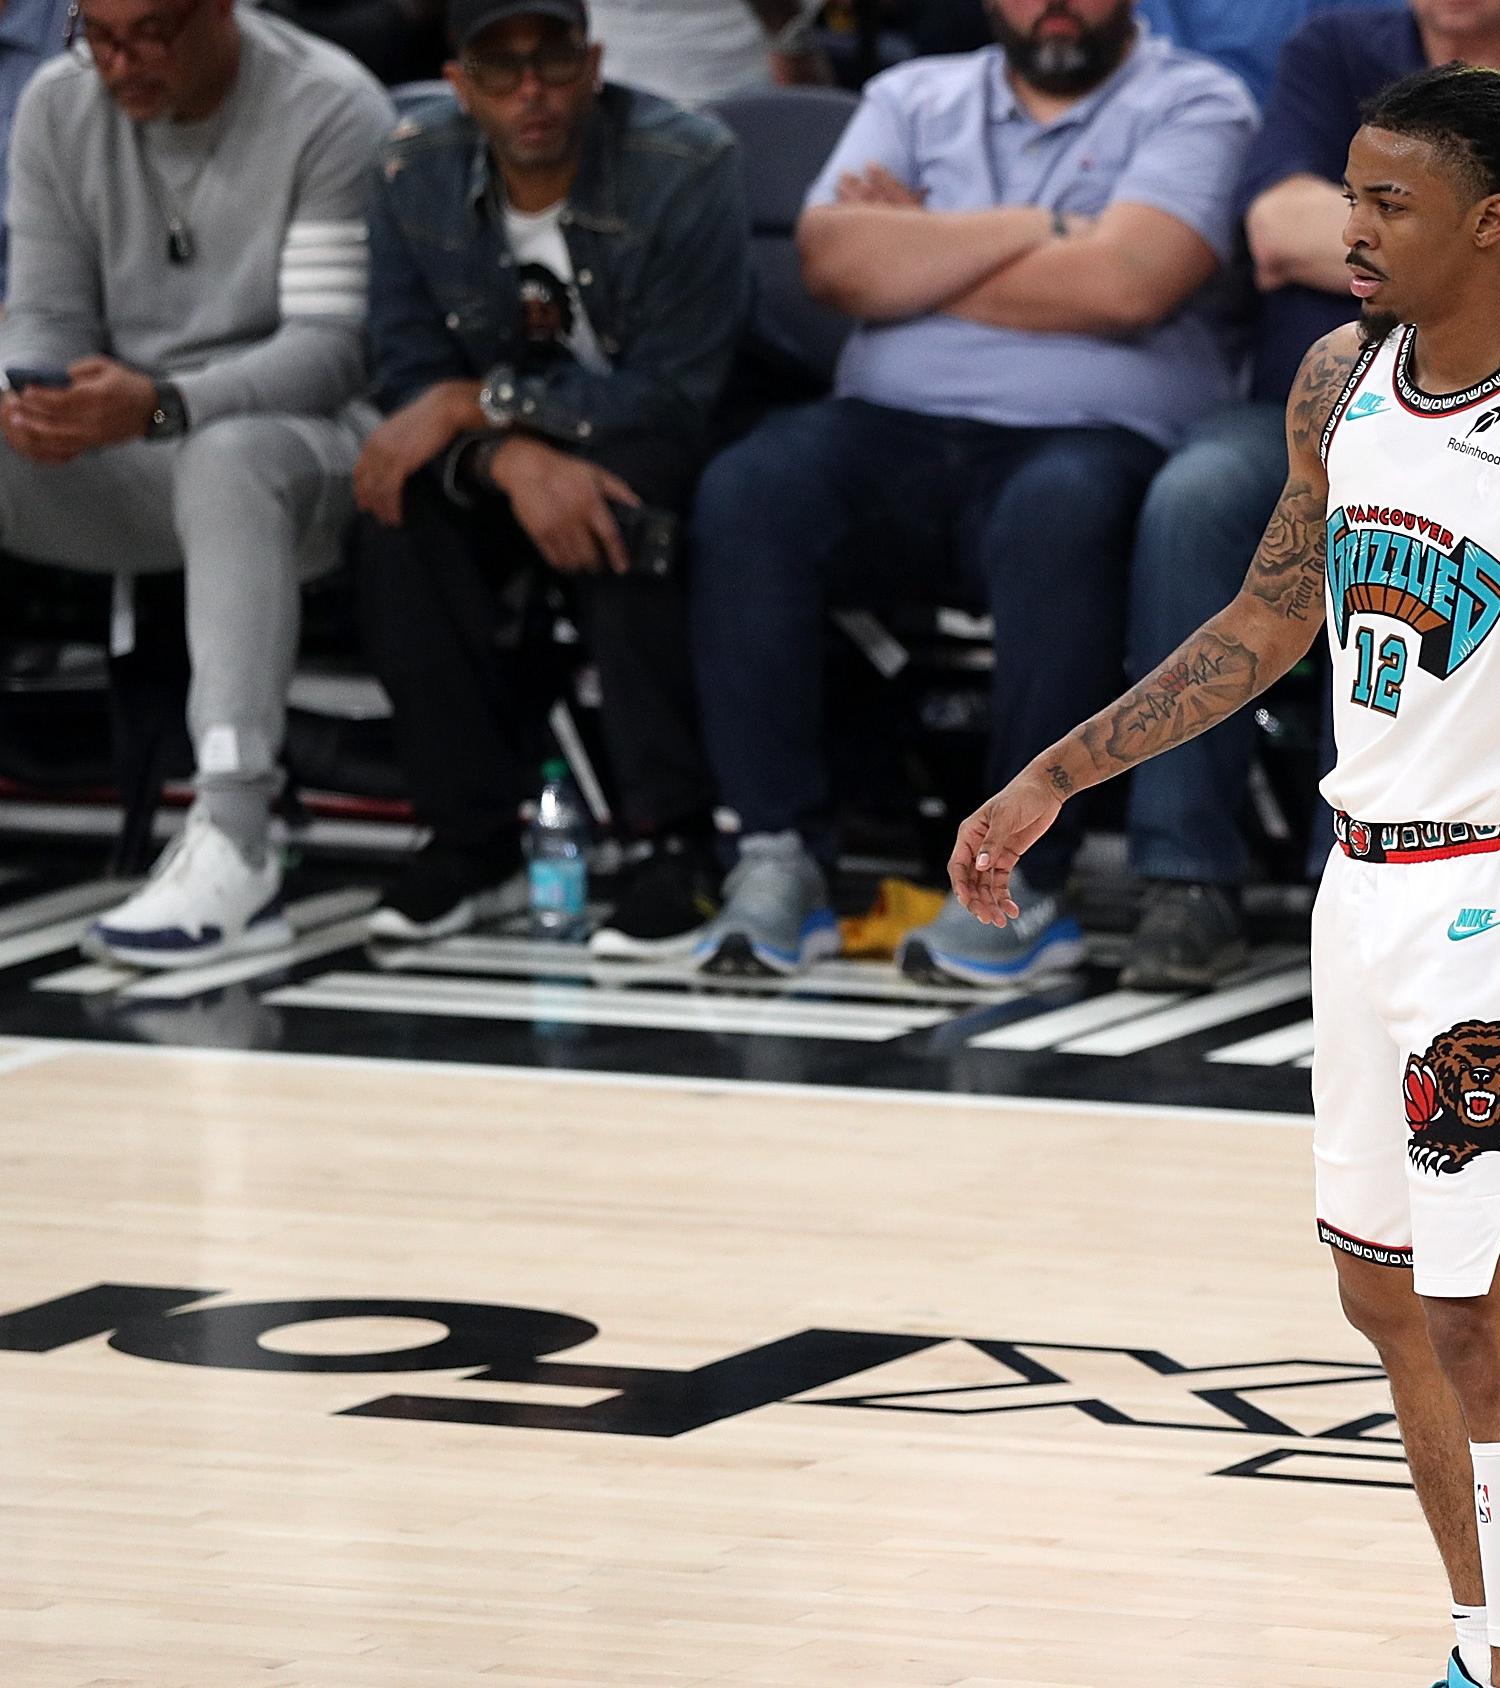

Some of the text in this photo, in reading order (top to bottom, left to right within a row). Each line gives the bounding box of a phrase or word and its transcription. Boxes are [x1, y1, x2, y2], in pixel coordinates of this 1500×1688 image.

[1354, 391, 1386, 412] NIKE
[1346, 504, 1455, 549] VANCOUVER
[1351, 625, 1408, 719] 12
[1456, 908, 1497, 928] NIKE
